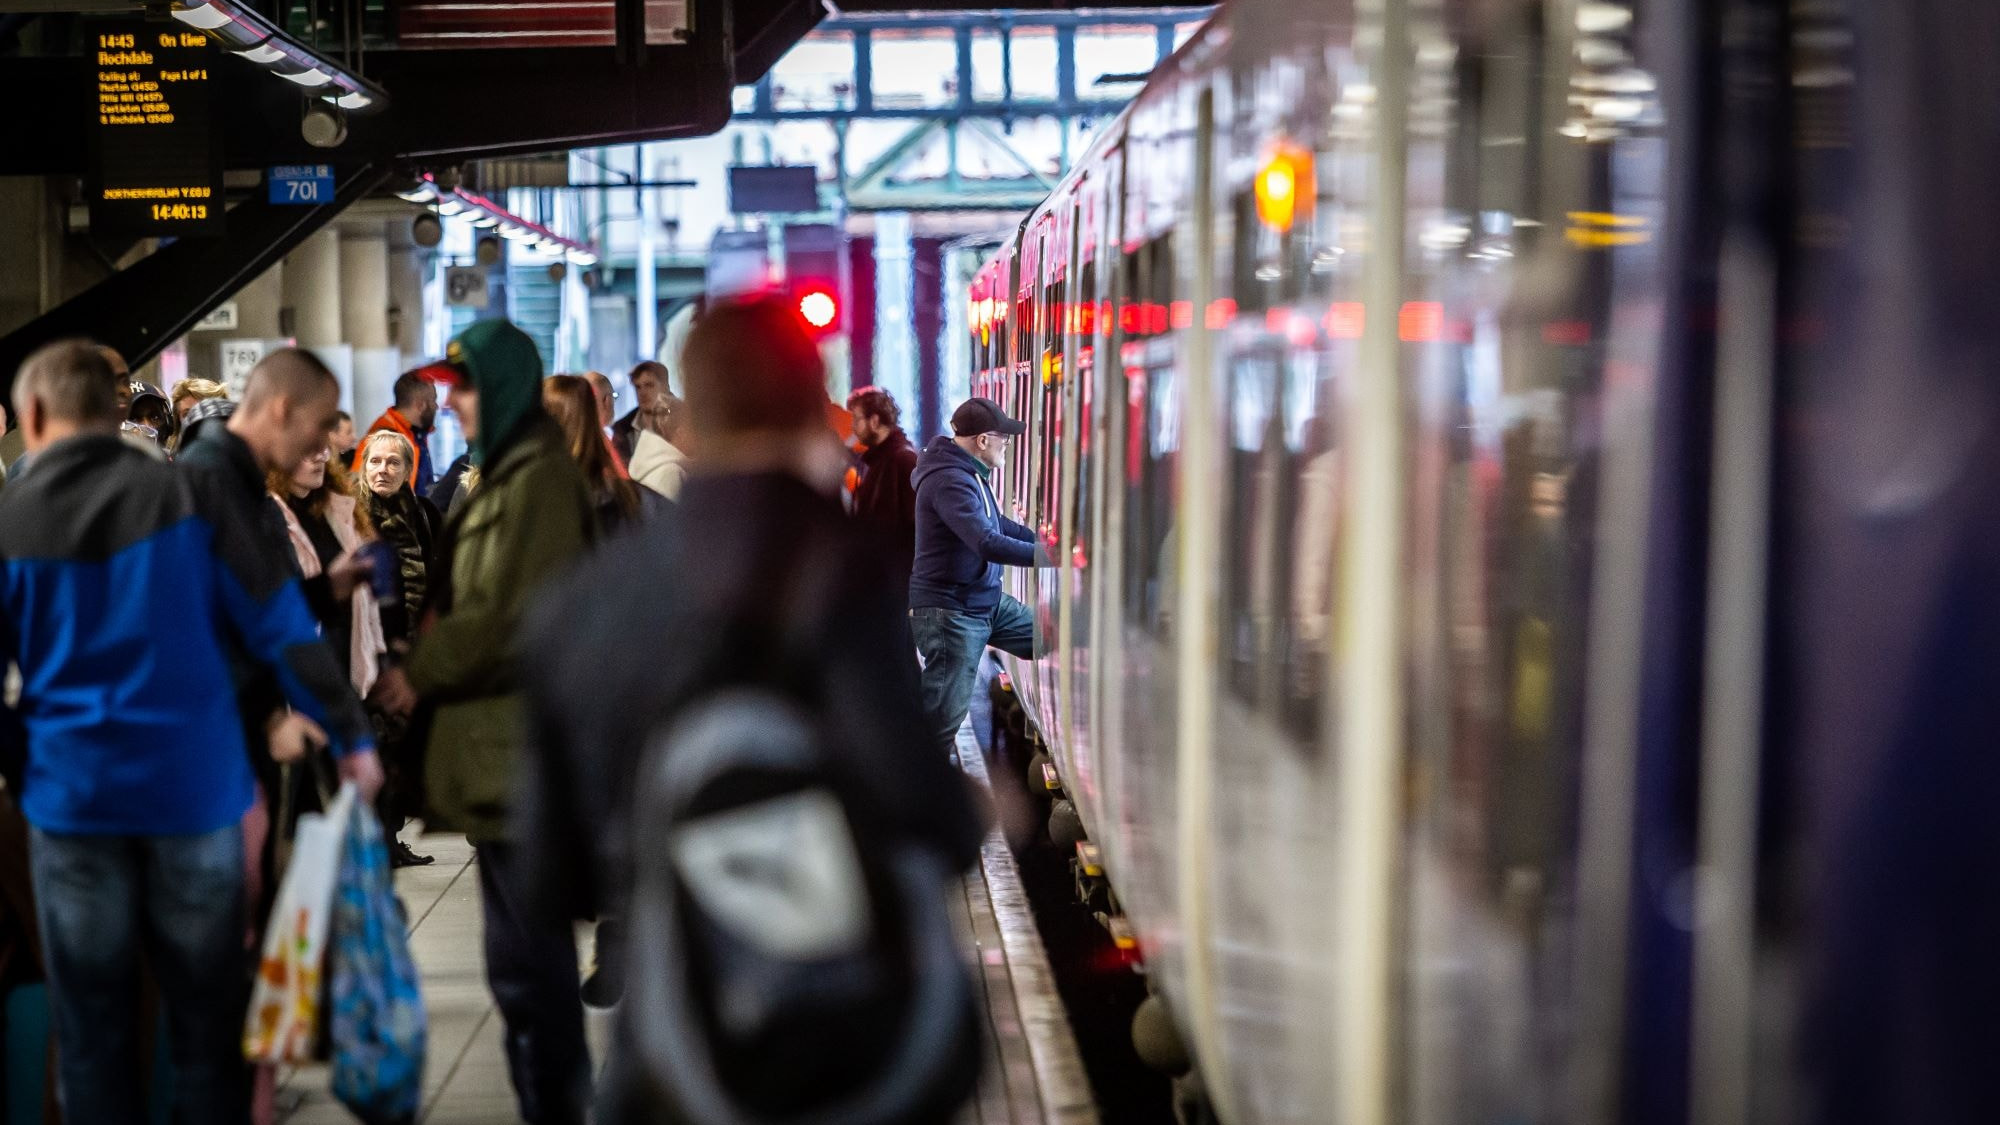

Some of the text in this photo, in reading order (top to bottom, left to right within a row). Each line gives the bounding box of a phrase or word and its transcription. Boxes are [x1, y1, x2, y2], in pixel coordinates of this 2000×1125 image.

[100, 32, 206, 48] 14:43 On time
[99, 51, 153, 65] Rochdale
[99, 71, 127, 83] Calling
[160, 70, 181, 82] Page
[182, 69, 188, 80] 1
[189, 69, 200, 80] of
[201, 69, 207, 80] 1
[286, 181, 317, 200] 701
[153, 203, 207, 220] 14:40:13
